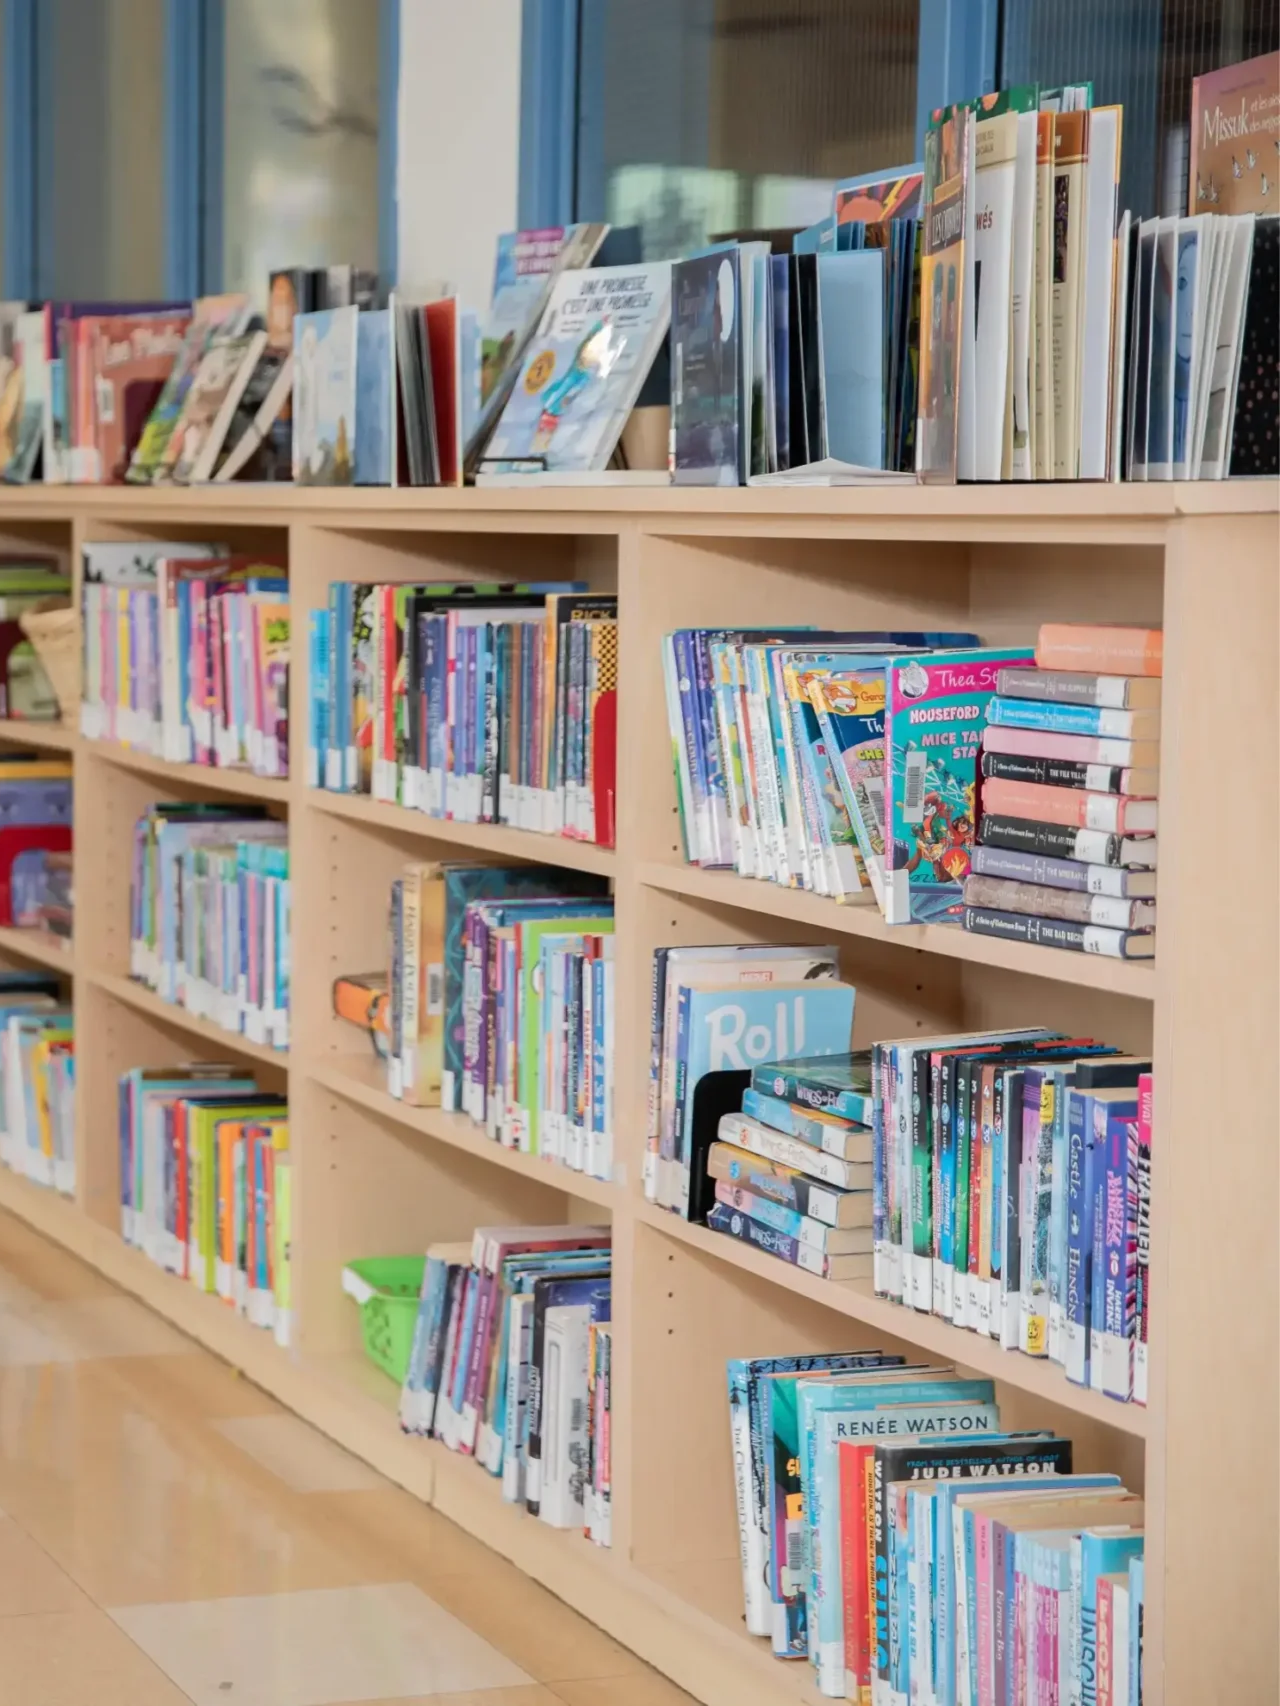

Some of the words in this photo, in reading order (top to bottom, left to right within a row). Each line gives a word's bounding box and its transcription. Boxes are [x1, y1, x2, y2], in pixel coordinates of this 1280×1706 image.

[1203, 97, 1249, 149] Missuk
[935, 670, 976, 688] Thea
[980, 668, 998, 685] St
[910, 706, 980, 724] MOUSEFORD
[922, 732, 957, 747] MICE
[962, 731, 984, 743] TA
[953, 746, 977, 759] STA
[1050, 768, 1058, 778] THE
[1071, 770, 1088, 780] VILLAG
[1042, 928, 1053, 938] THE
[1055, 930, 1065, 940] BAD
[705, 996, 805, 1070] Roll
[958, 1078, 965, 1091] 2
[971, 1080, 977, 1093] 3
[983, 1125, 990, 1144] 39
[1137, 1157, 1151, 1265] FRAZZLED
[837, 1417, 897, 1436] RENÉE
[907, 1416, 989, 1433] WATSON
[931, 1459, 944, 1467] THE
[946, 1457, 992, 1466] BESTSELLING
[996, 1456, 1024, 1464] AUTHOR
[910, 1467, 961, 1480] JUDE
[969, 1462, 1056, 1478] WATSON
[874, 1460, 883, 1543] WATSON
[876, 1555, 888, 1669] STING
[910, 1609, 916, 1621] ME
[996, 1589, 1004, 1638] Farmer
